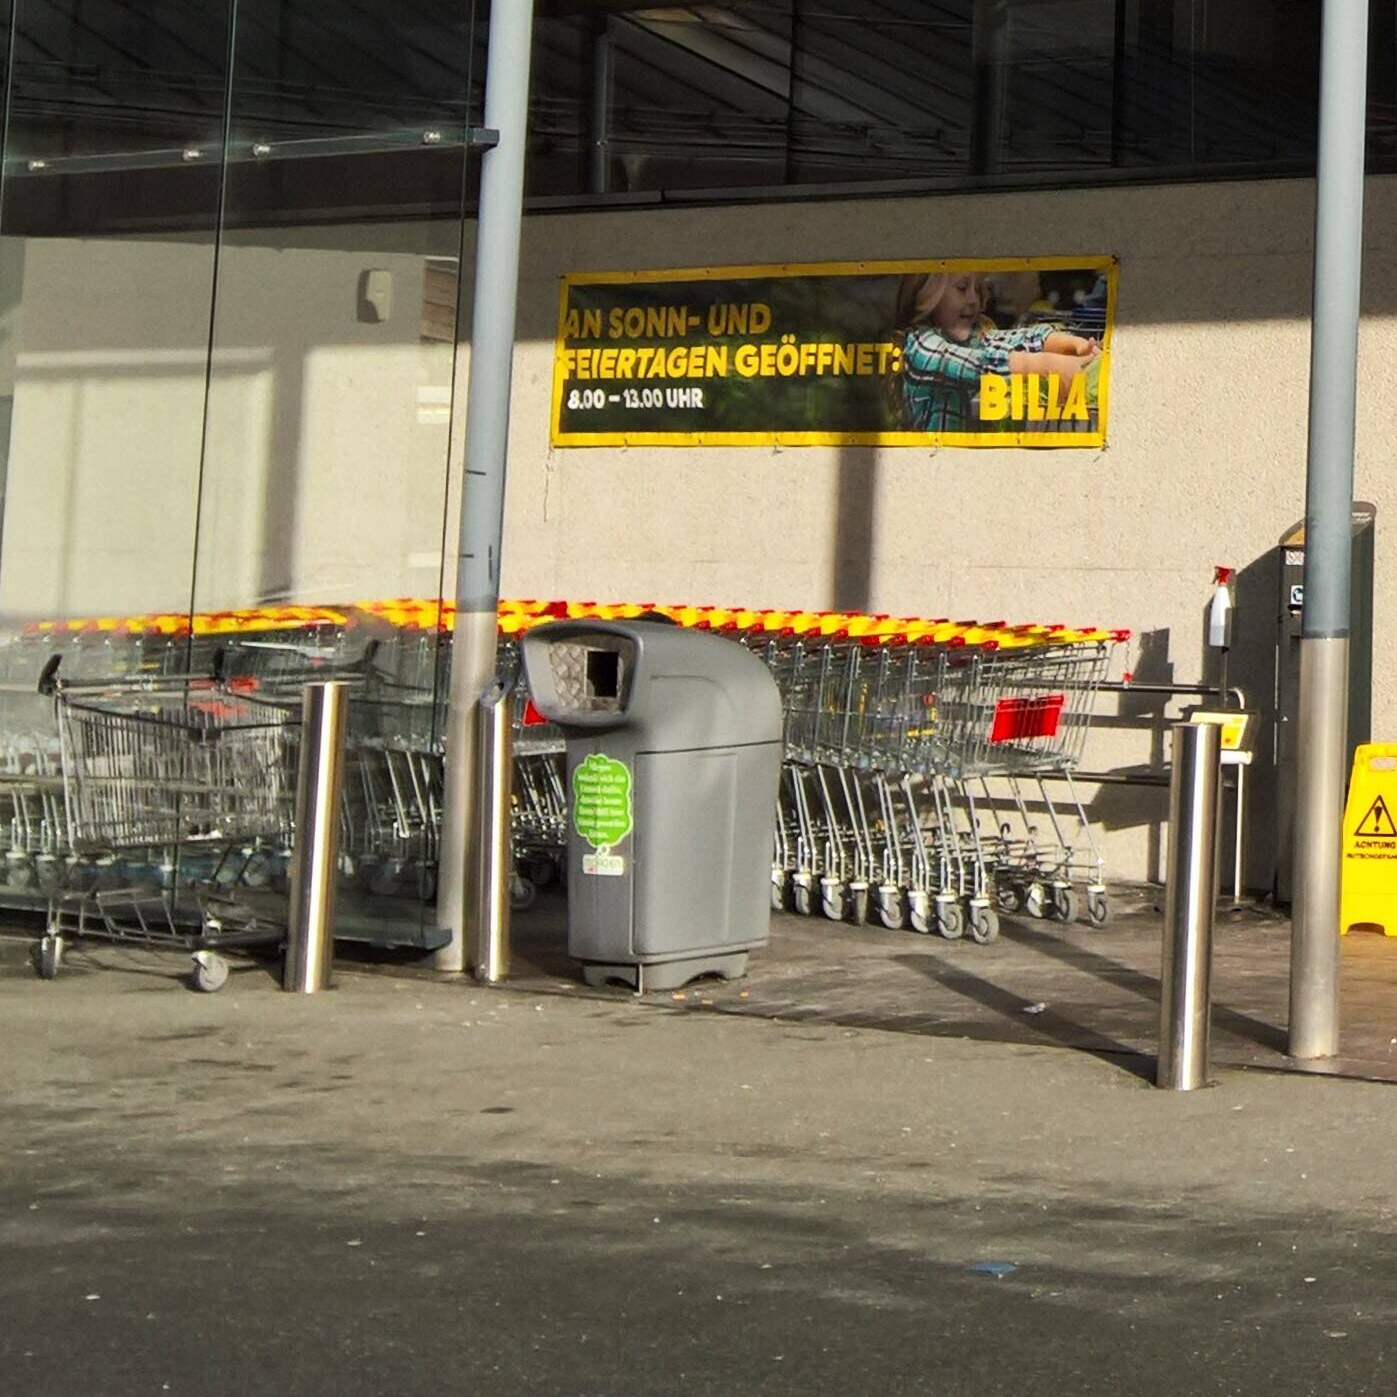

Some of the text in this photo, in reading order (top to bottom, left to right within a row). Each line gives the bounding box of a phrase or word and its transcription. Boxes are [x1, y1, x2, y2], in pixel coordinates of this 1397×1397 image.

[564, 302, 772, 339] AN SONN- UND
[562, 335, 903, 380] FEIERTAGEN GEÖFFNET:
[567, 389, 605, 410] 8.00
[624, 388, 664, 409] 13.00
[665, 388, 704, 409] UHR
[979, 373, 1089, 421] BILLA
[1354, 840, 1396, 850] ACHTUNG
